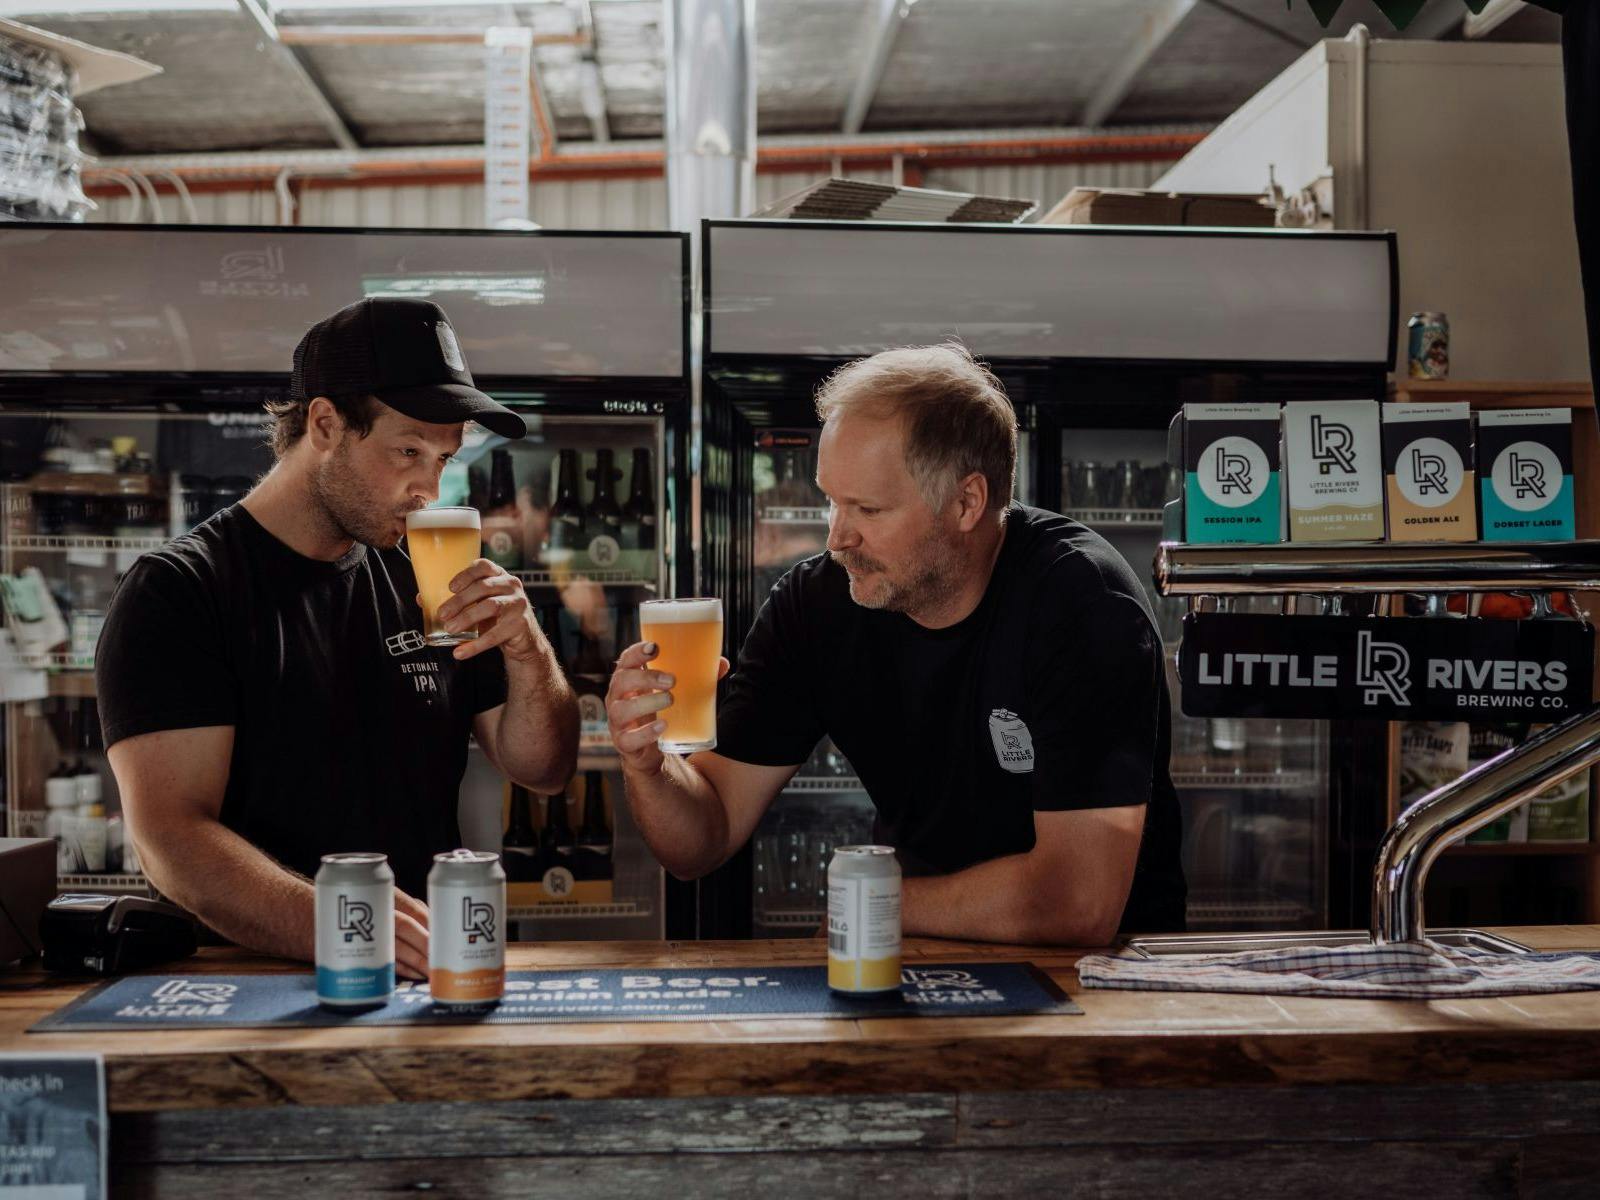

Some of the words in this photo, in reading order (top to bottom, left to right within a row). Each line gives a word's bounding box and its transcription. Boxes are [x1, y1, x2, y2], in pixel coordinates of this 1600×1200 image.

[1309, 481, 1332, 489] LITTLE
[1314, 487, 1347, 495] BREWING
[1204, 516, 1243, 524] SESSION
[1246, 516, 1262, 524] IPA
[1298, 515, 1342, 524] SUMMER
[1345, 513, 1374, 522] HAZE
[1404, 516, 1440, 524] GOLDEN
[1443, 515, 1460, 523] ALE
[1494, 520, 1530, 529] DORSET
[1533, 519, 1563, 528] LAGER
[401, 662, 439, 673] DETONATE
[1198, 652, 1338, 687] LITTLE
[1427, 658, 1568, 692] RIVERS
[414, 675, 437, 692] IPA
[1457, 694, 1534, 708] BREWING
[1540, 696, 1569, 709] CO.
[1002, 749, 1031, 757] LITTLE
[621, 975, 780, 989] Beer.
[624, 989, 743, 999] made.
